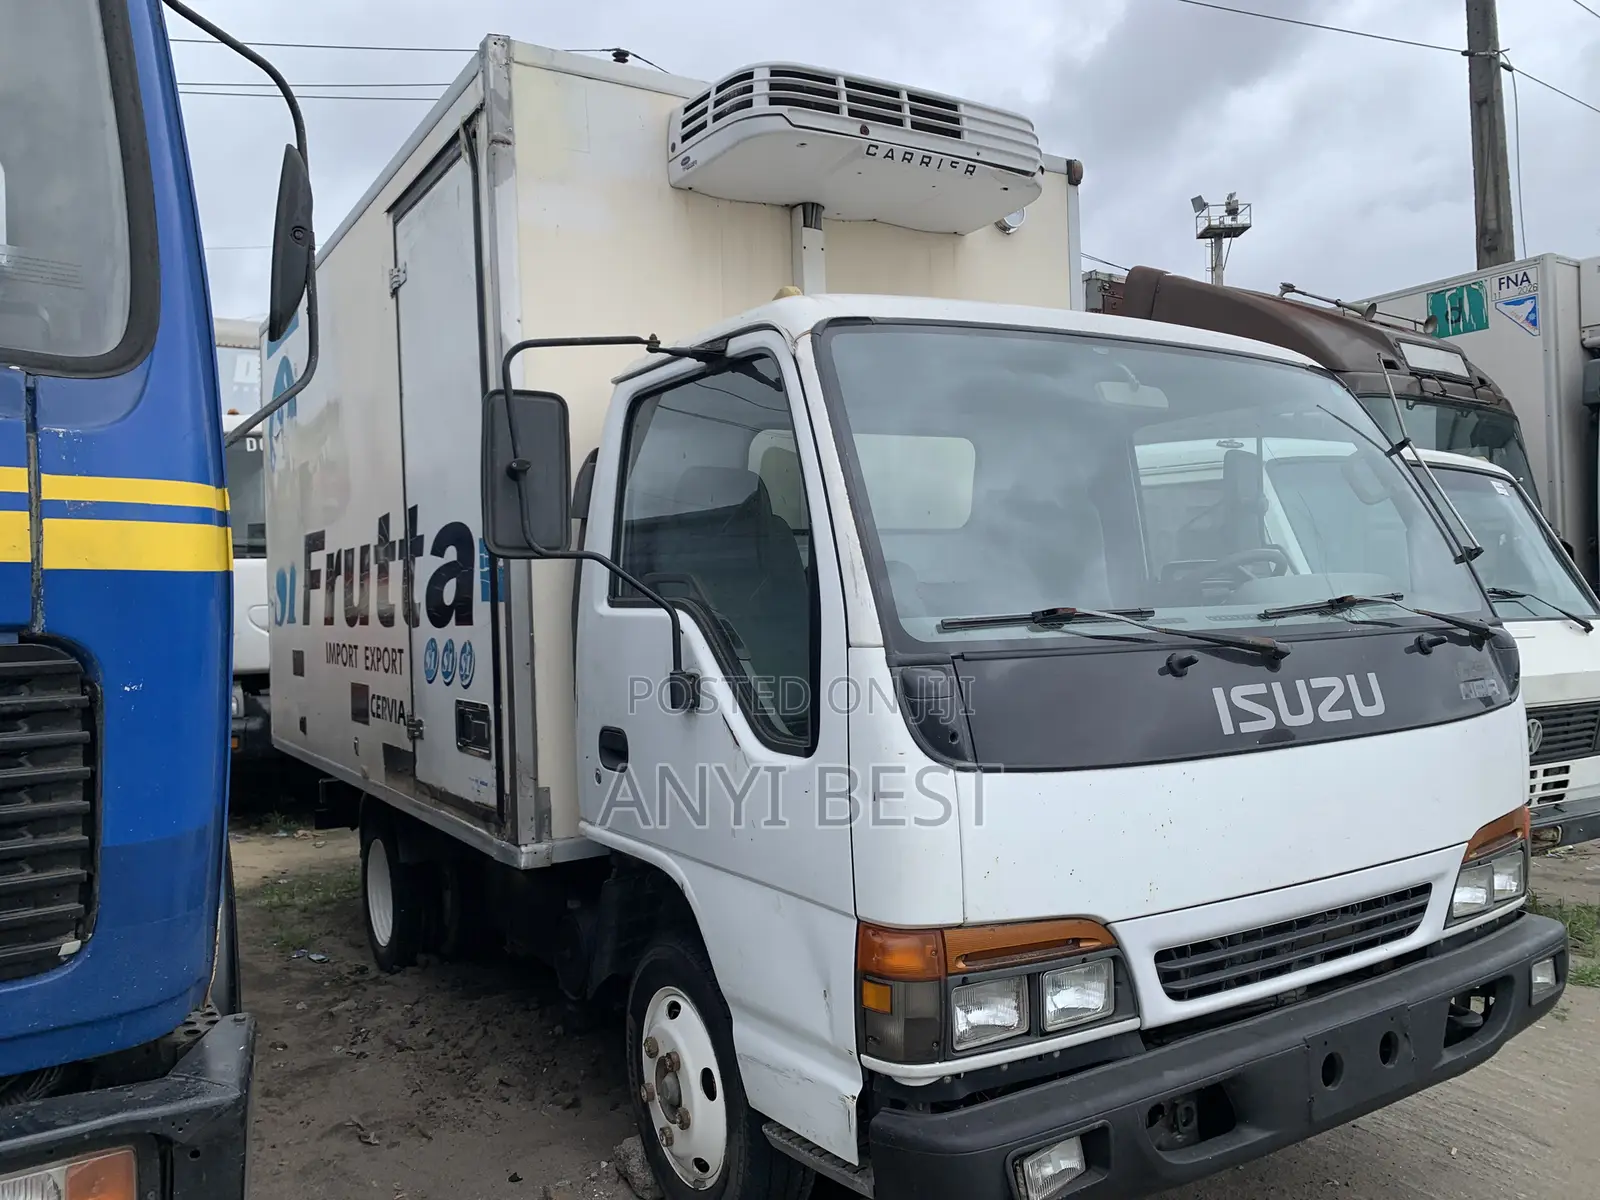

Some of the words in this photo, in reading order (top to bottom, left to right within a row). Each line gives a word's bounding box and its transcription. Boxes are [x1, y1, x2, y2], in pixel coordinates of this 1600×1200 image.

[1498, 271, 1531, 291] FNA
[1518, 282, 1538, 295] 2026
[246, 437, 263, 452] D
[303, 504, 475, 628] Frutta
[326, 641, 358, 668] IMPORT
[364, 646, 404, 675] EXPORT
[371, 694, 407, 726] CERVIA
[1212, 672, 1386, 735] ISUZU
